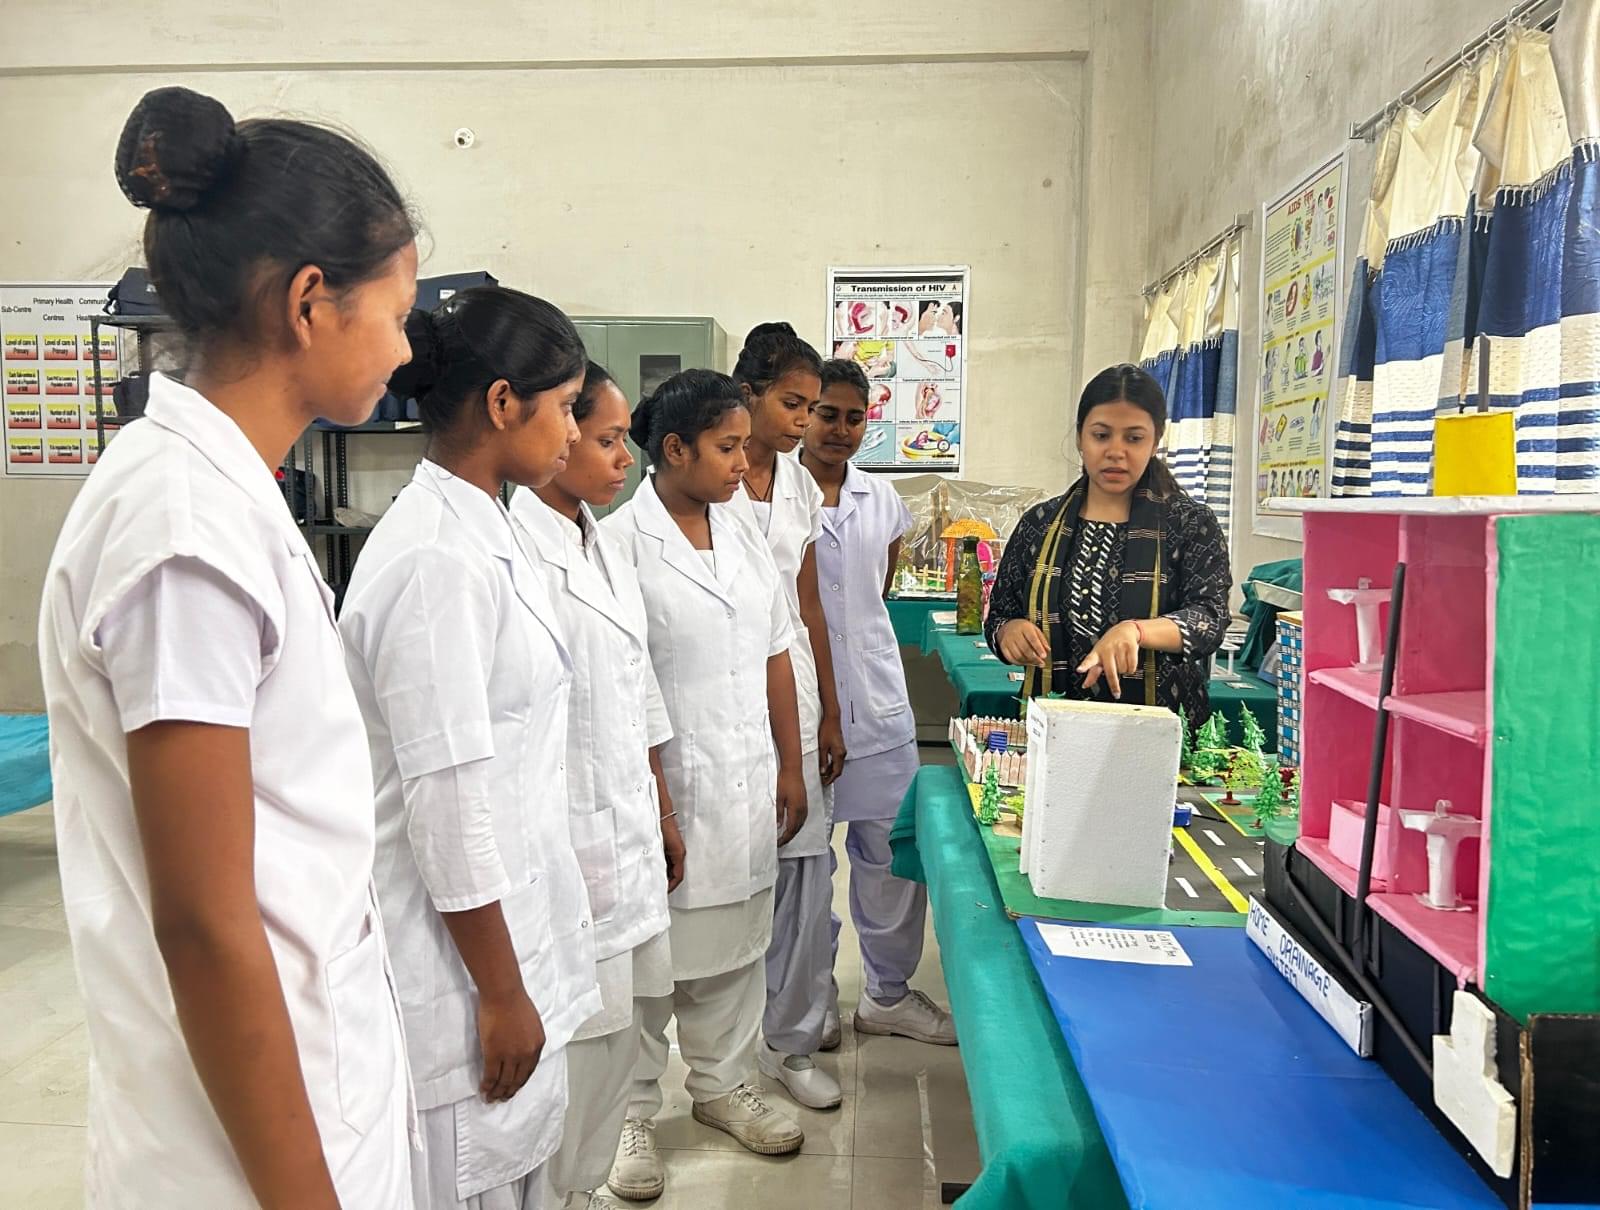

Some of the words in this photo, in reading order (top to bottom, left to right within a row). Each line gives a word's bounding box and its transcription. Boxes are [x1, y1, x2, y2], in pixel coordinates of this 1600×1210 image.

[1287, 198, 1302, 216] AIDS
[851, 285, 913, 293] Transmission
[915, 285, 925, 294] of
[928, 285, 945, 294] HIV
[33, 298, 54, 306] Primary
[1250, 903, 1270, 937] HOME
[1280, 934, 1331, 997] DRAINAGE
